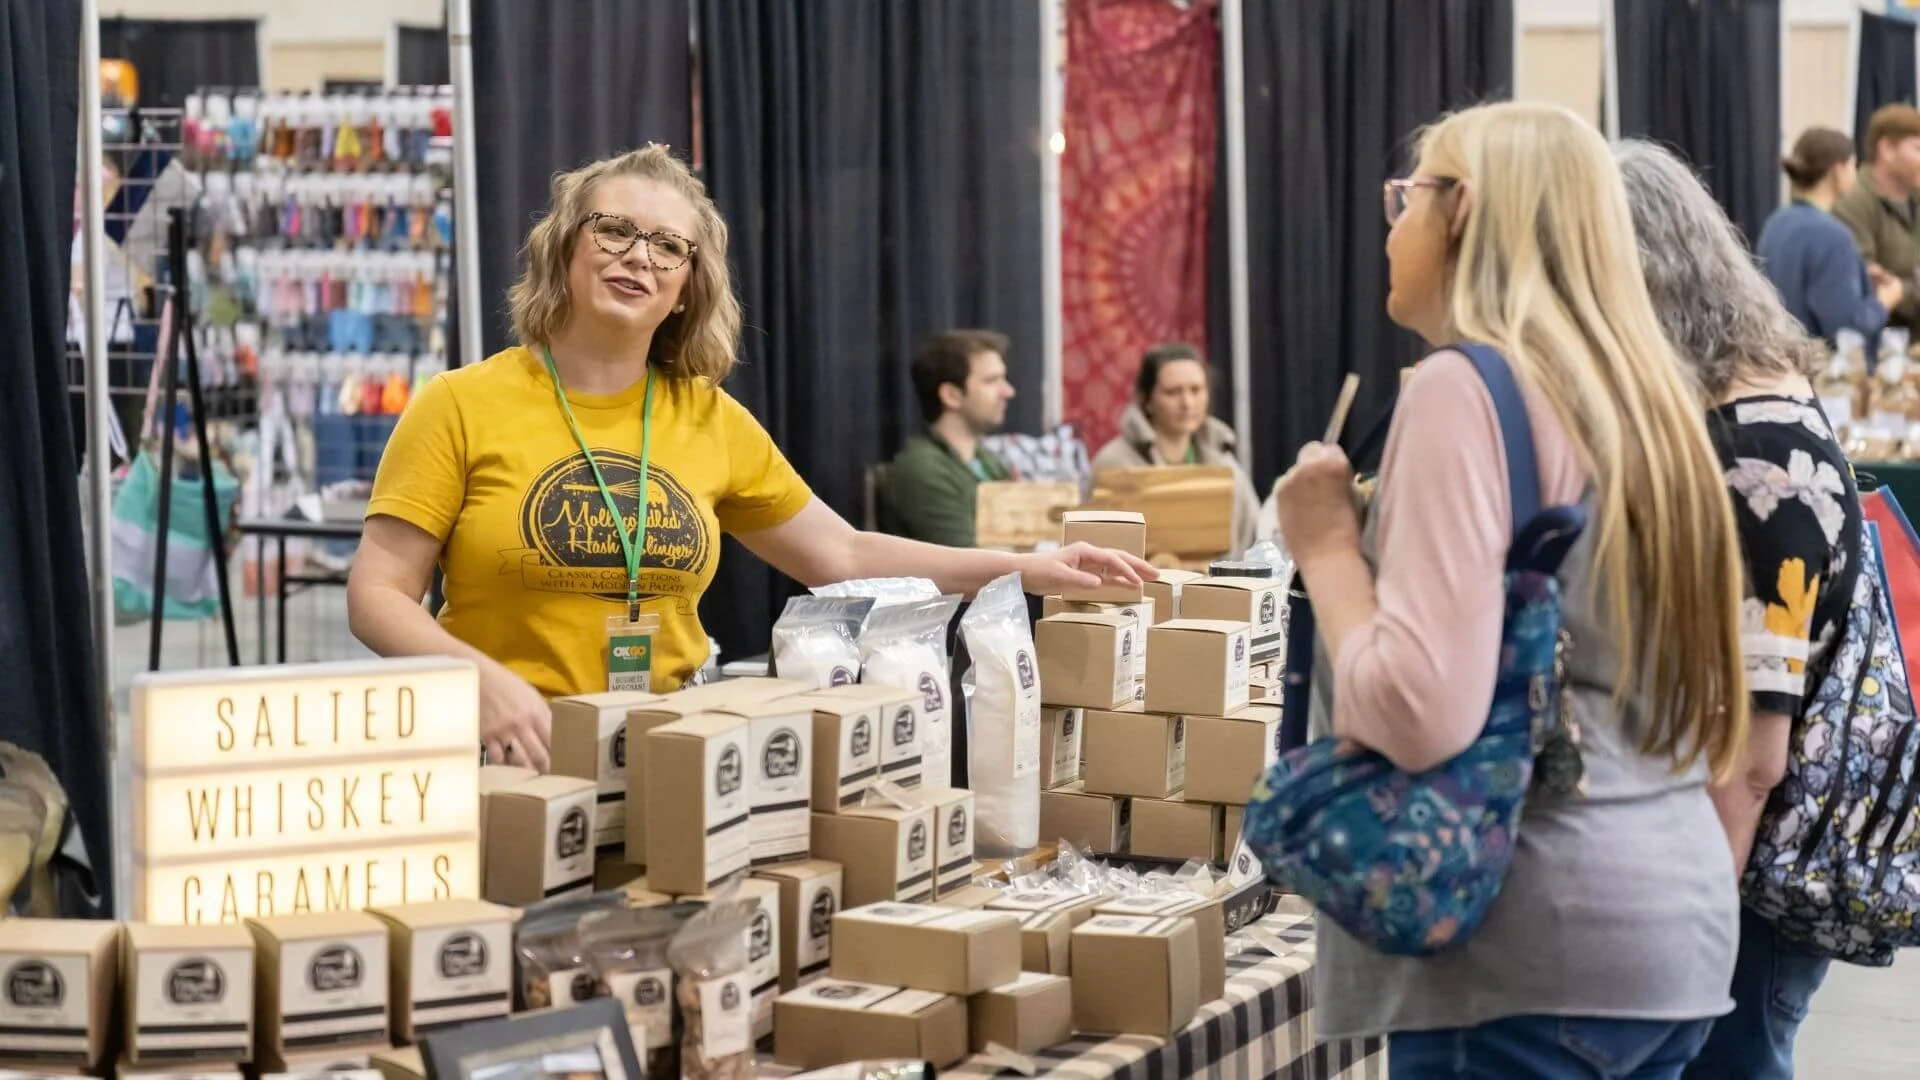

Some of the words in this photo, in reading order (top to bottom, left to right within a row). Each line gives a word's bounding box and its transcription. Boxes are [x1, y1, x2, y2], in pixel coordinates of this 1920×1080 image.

[542, 499, 682, 538] Mollcodled
[636, 533, 695, 568] linger
[592, 579, 645, 590] MODEN
[600, 570, 681, 582] CONCTIONS
[216, 685, 416, 752] SALTED
[186, 770, 433, 841] WHISKEY
[183, 854, 451, 925] CARAMELS
